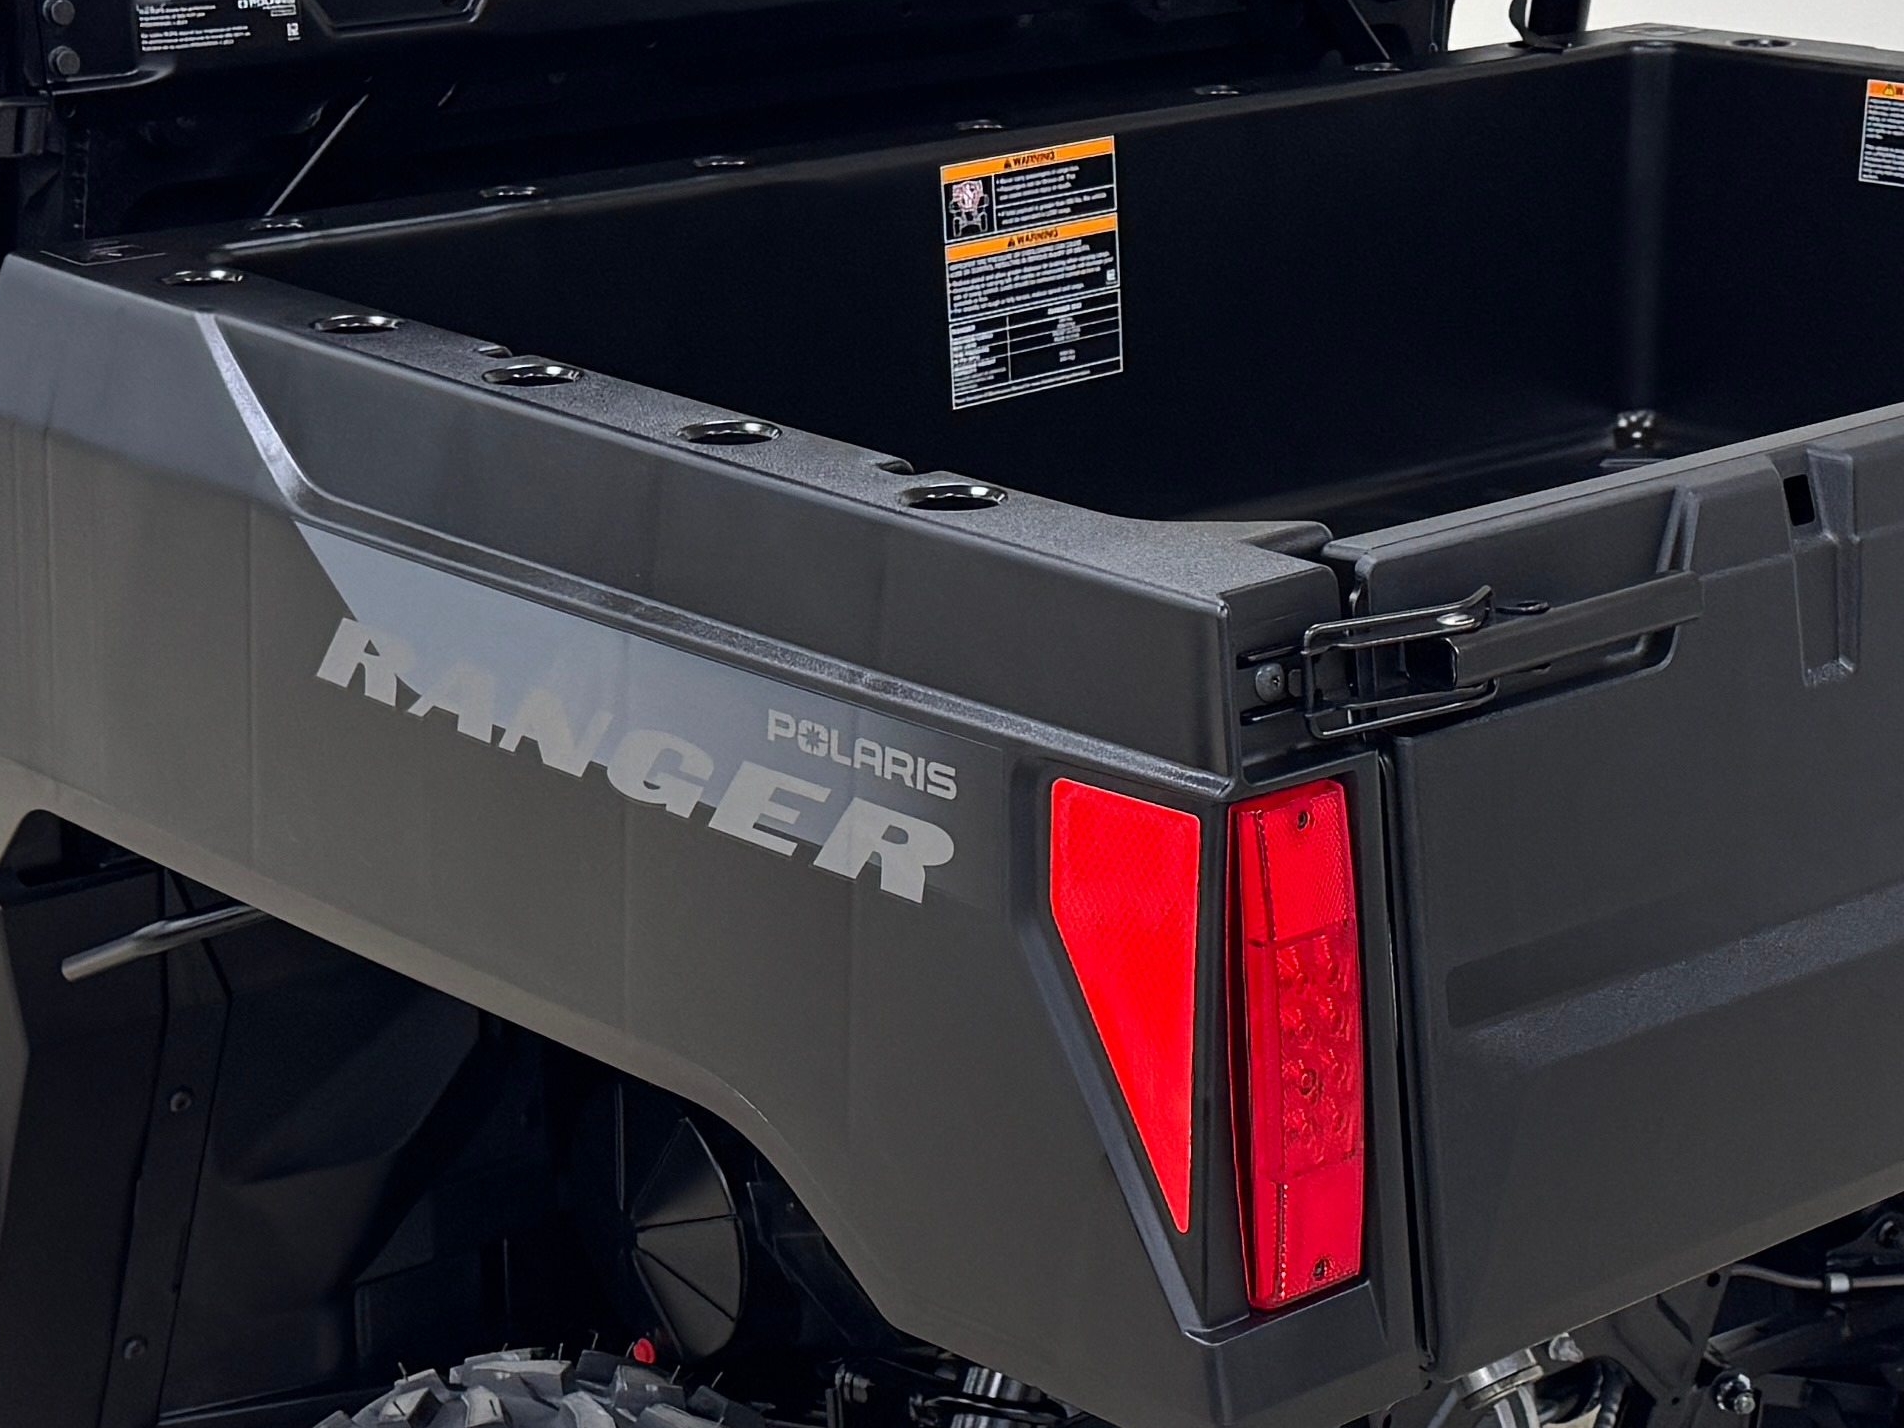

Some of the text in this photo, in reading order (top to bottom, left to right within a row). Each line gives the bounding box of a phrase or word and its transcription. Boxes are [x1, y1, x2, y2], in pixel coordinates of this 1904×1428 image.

[1013, 151, 1055, 166] WARNING
[1016, 228, 1059, 245] WARNING
[316, 617, 955, 904] RANGER
[767, 709, 958, 800] POLARIS
